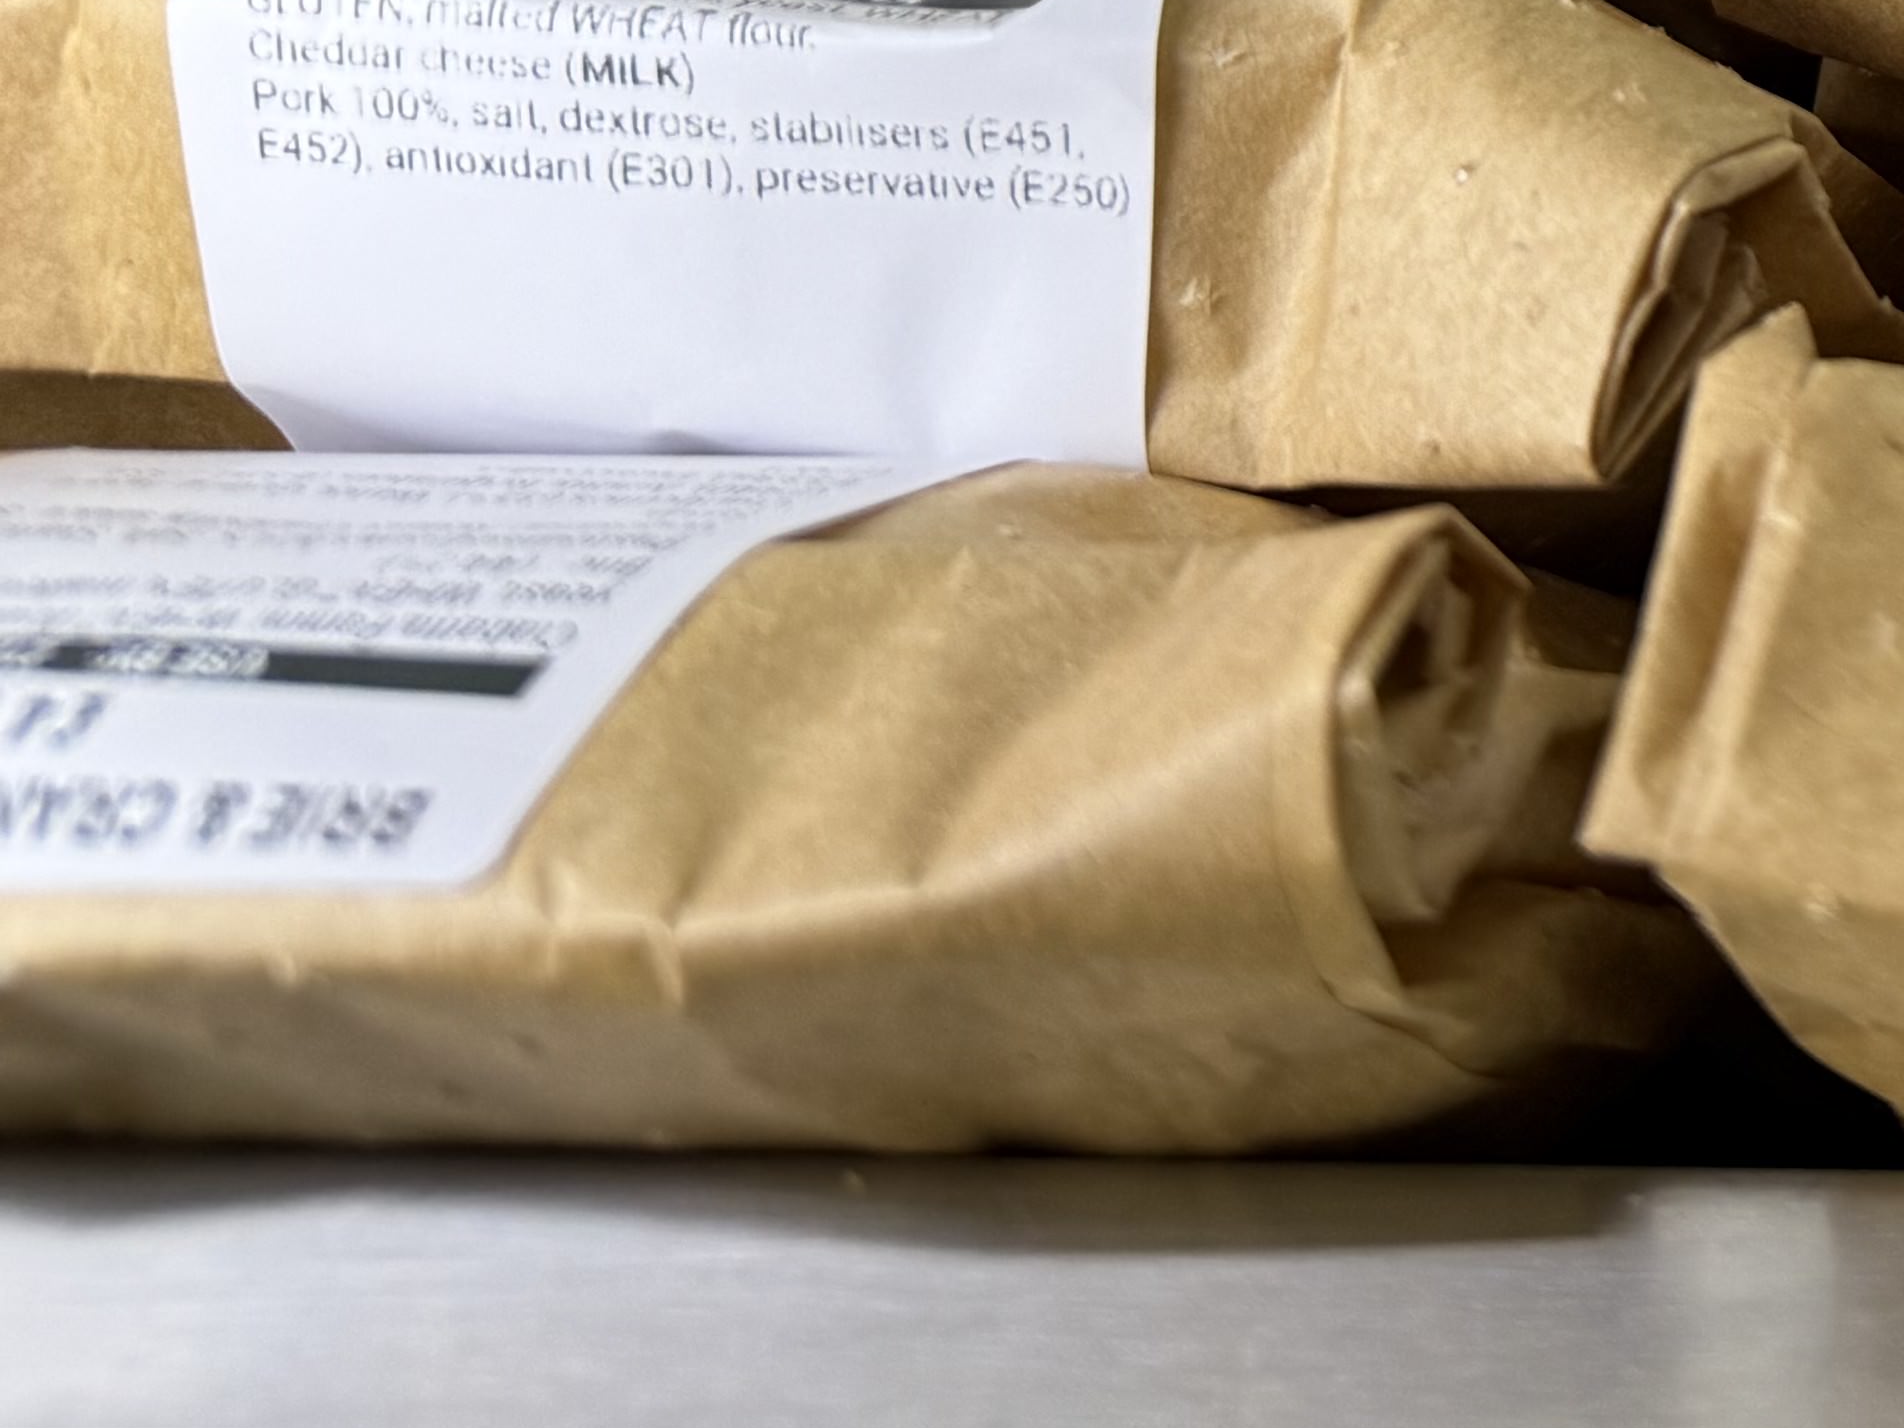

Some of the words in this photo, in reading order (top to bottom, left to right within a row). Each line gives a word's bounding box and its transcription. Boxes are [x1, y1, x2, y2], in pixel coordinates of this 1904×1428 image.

[420, 45, 551, 81] cheese
[565, 51, 695, 91] (MILK)
[252, 77, 336, 115] Pork
[750, 112, 949, 151] stabilisers
[385, 147, 592, 182] antioxidant
[755, 164, 995, 201] preservative
[1008, 165, 1131, 211] (E250)
